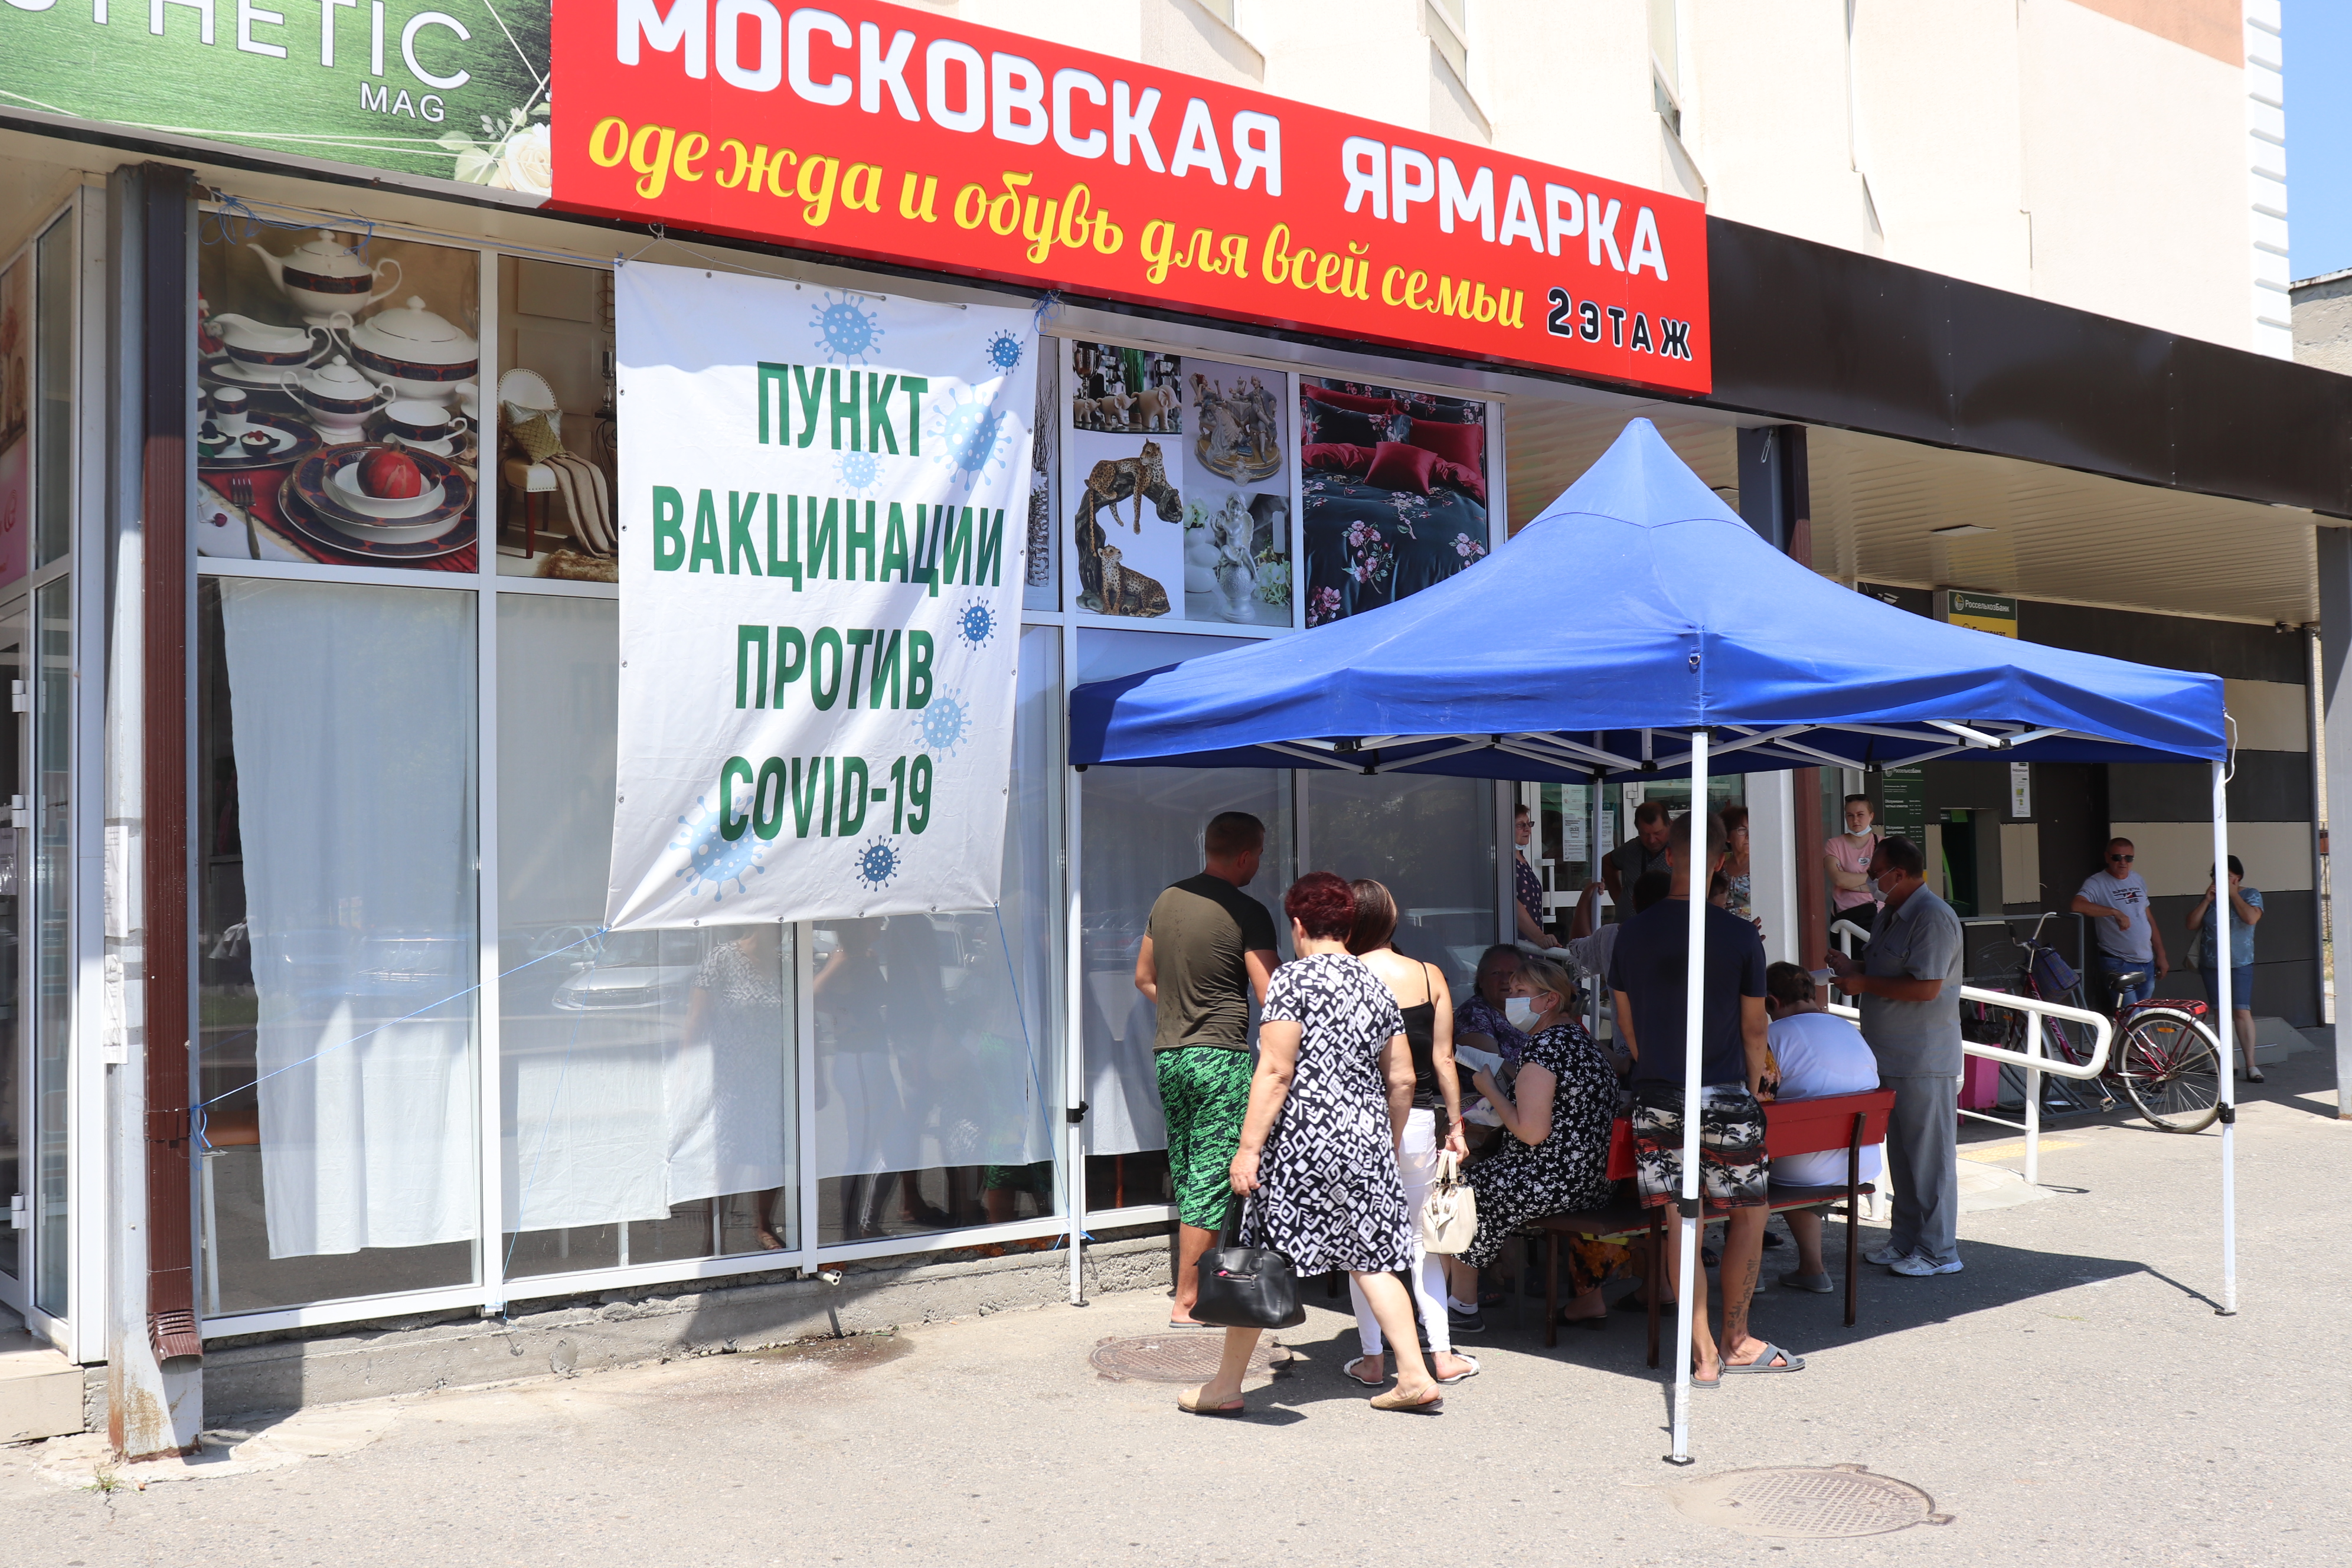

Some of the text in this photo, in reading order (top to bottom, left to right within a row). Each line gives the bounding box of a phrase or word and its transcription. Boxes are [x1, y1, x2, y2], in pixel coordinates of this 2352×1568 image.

[4, 0, 472, 89] HETIC
[360, 81, 446, 123] MAG
[616, 0, 1669, 282] МОСКОВСКАЯ ЯРМАРКА
[588, 115, 884, 227] одежда
[898, 170, 939, 223] и
[953, 169, 1125, 264] обувь
[1139, 218, 1250, 285] для
[1261, 221, 1370, 301] всей
[1380, 264, 1525, 329] семьи
[756, 360, 929, 457] ПУНКТ
[652, 485, 1005, 597] ВАКЦИНАЦИИ
[1964, 599, 2010, 612] РоссельхозБанк
[734, 624, 934, 711] ПРОТИВ
[718, 754, 933, 842] COVID-19
